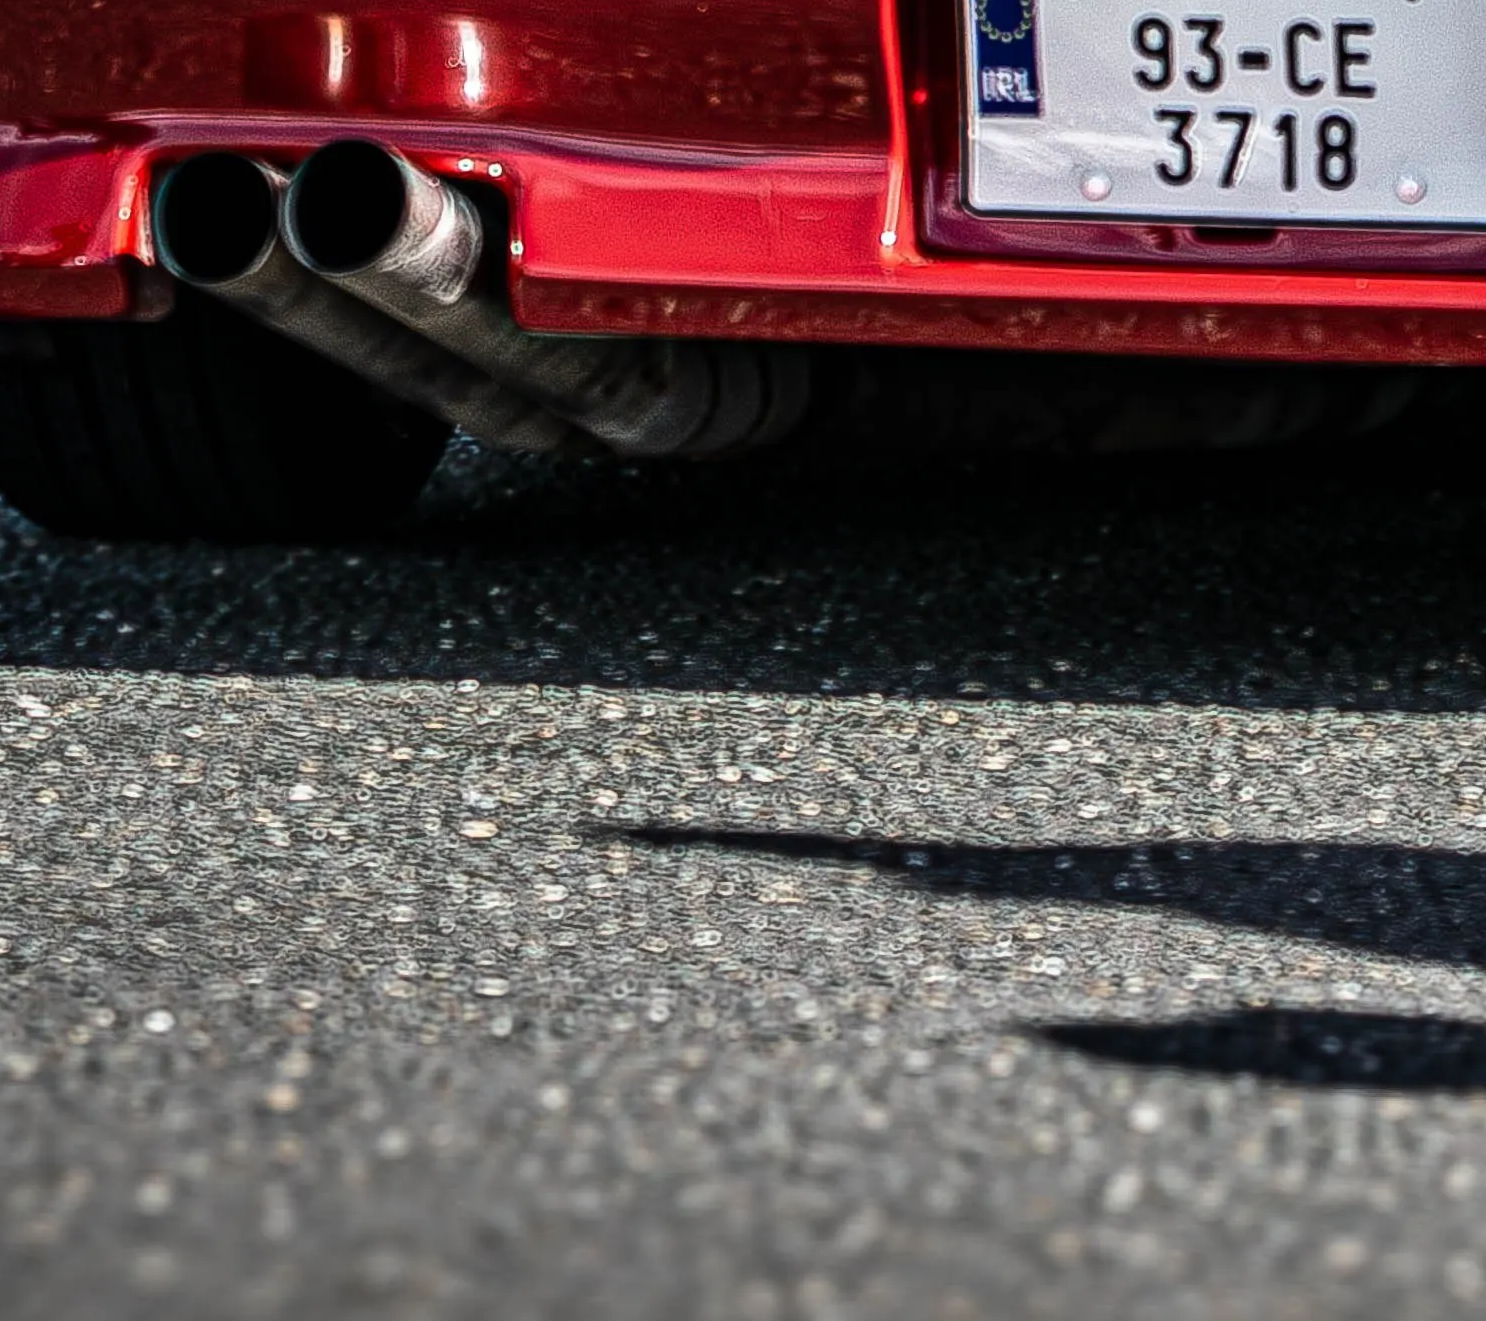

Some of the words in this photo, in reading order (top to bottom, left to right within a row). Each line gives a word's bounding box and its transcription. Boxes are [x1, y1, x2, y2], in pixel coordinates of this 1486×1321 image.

[982, 68, 1035, 102] IRL
[1132, 17, 1376, 98] 93-CE
[1154, 107, 1357, 191] 3718
